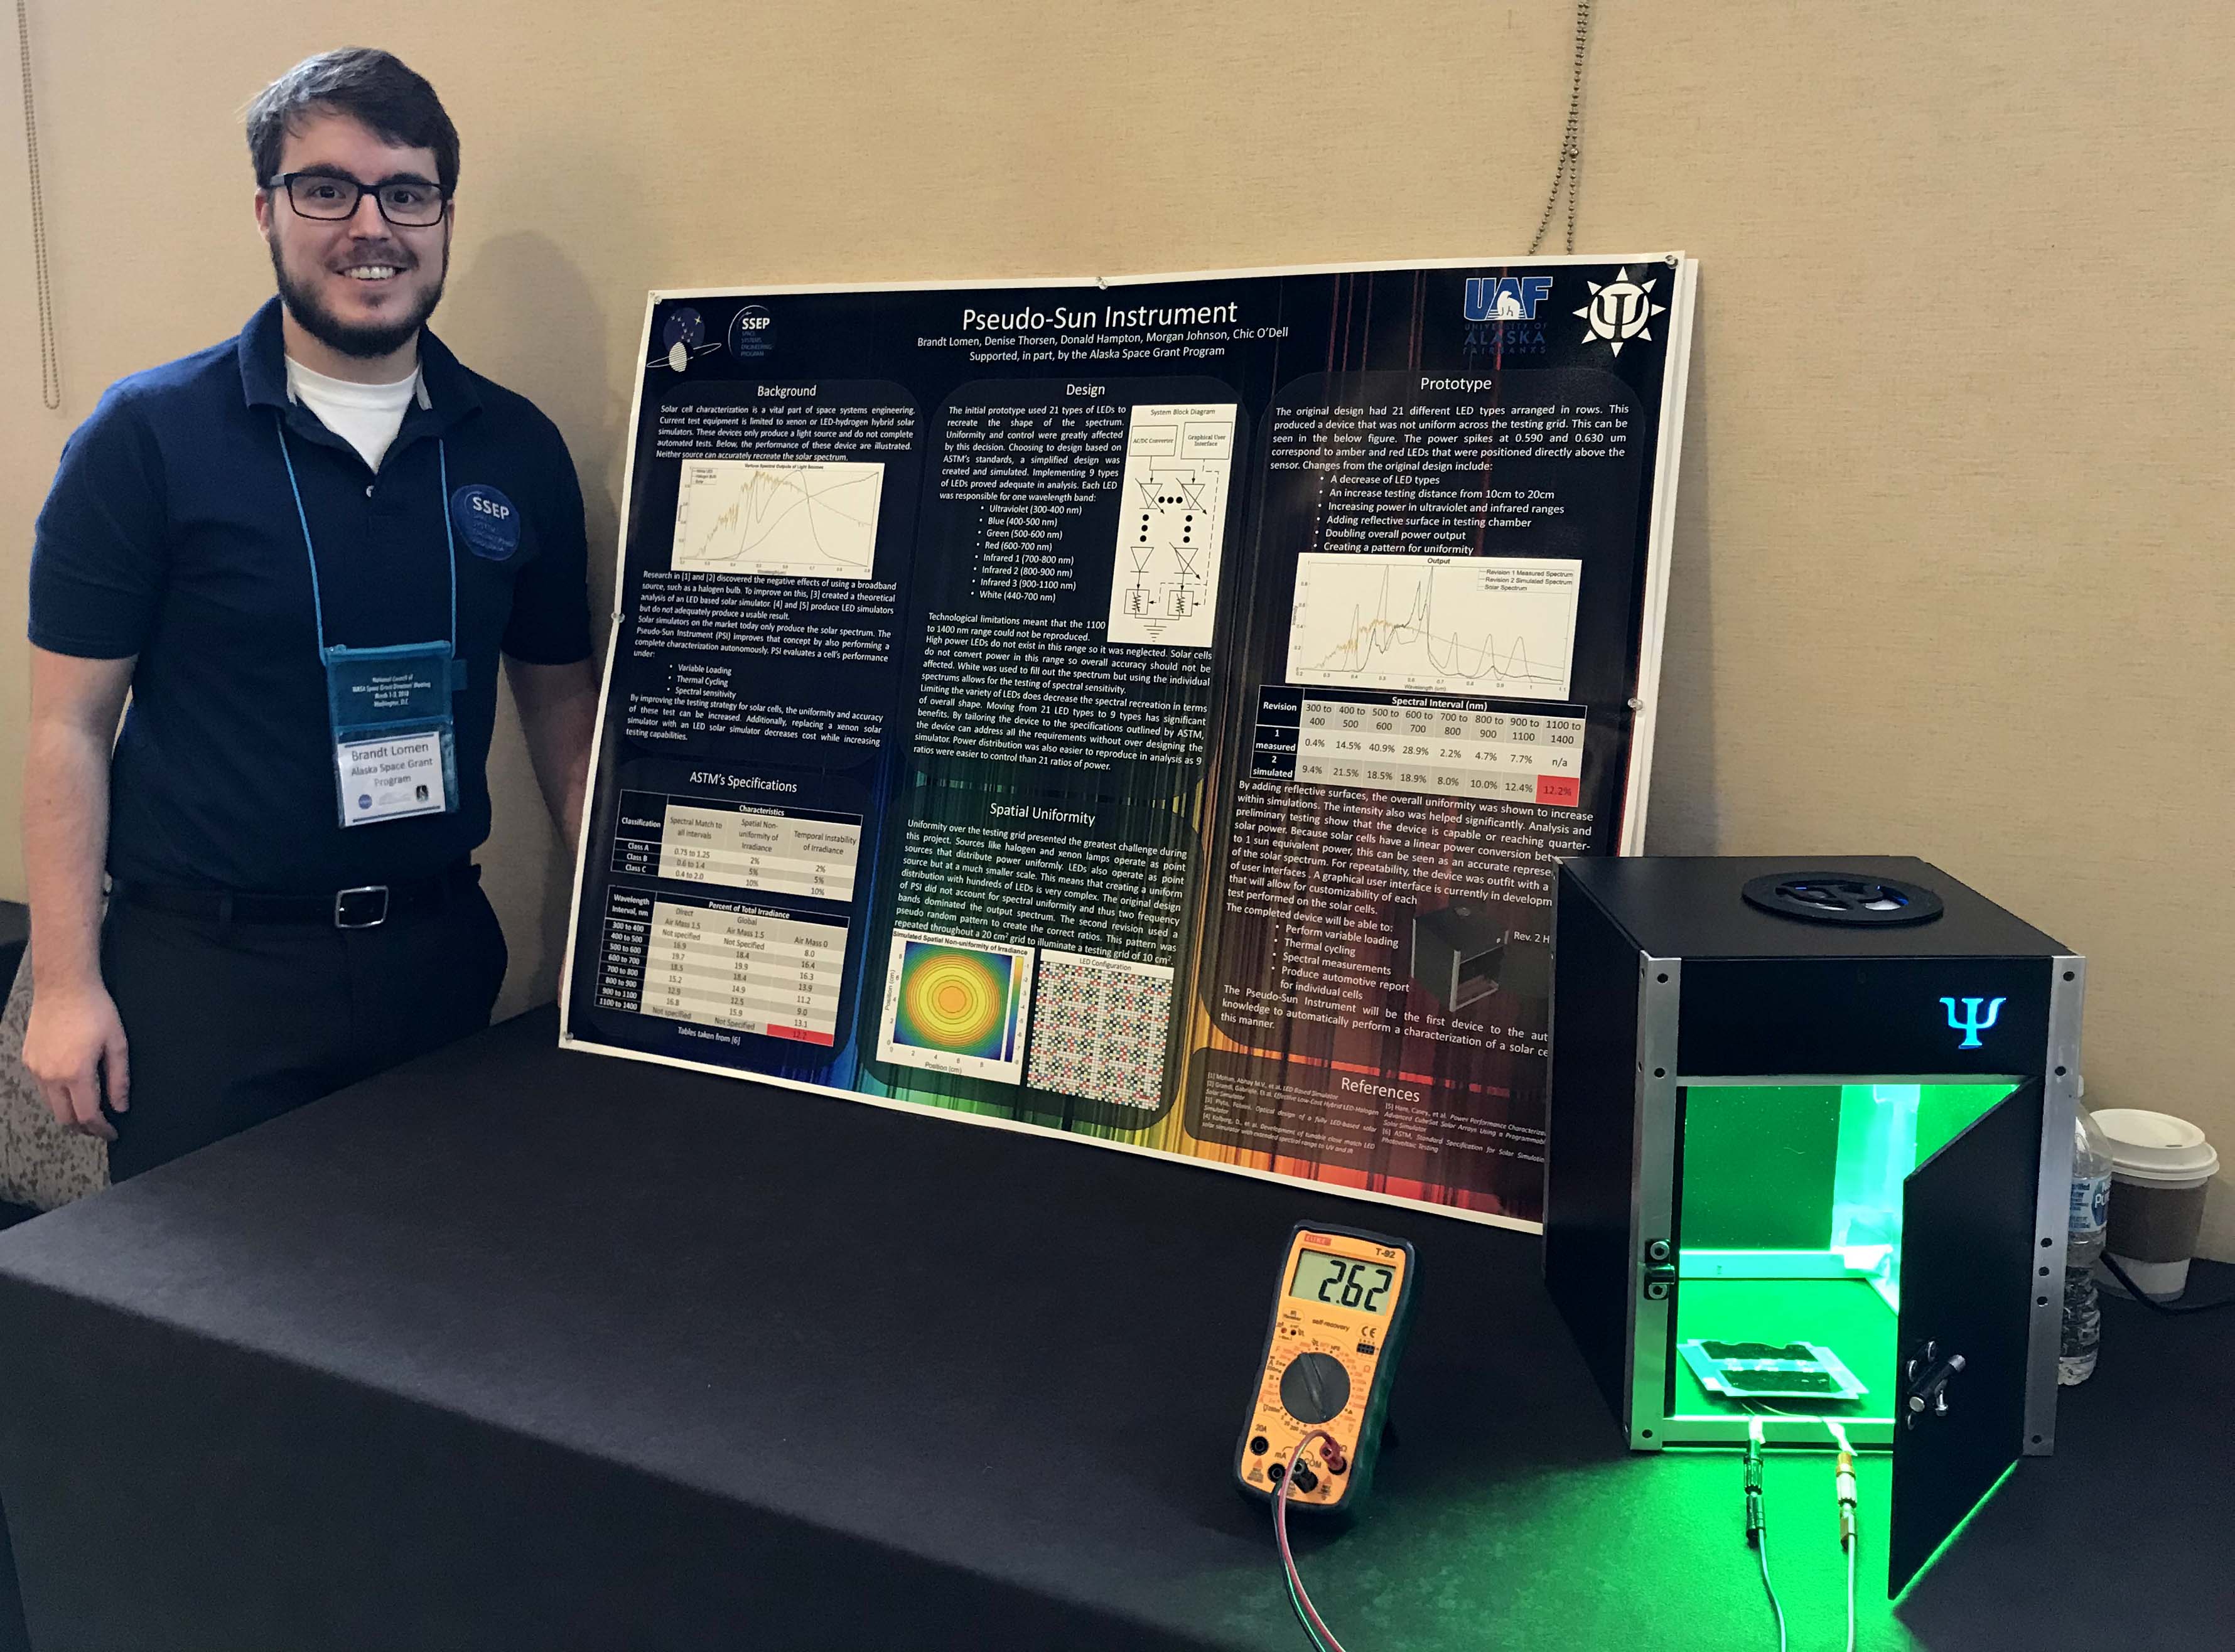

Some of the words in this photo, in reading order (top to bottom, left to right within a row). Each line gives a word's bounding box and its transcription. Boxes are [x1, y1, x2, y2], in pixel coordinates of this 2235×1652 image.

[1464, 276, 1553, 321] UAF
[962, 306, 1096, 331] Pseudo-Sun
[1105, 301, 1238, 328] Instrument
[742, 318, 770, 330] SSEP
[917, 336, 947, 347] Brandt
[949, 336, 982, 347] Lomen,
[984, 335, 1016, 346] Denise
[1018, 335, 1058, 345] Thorsen,
[1060, 333, 1094, 345] Donald
[1096, 333, 1143, 344] Hampton,
[1146, 331, 1184, 343] Morgan
[1185, 330, 1230, 341] Johnson,
[1232, 328, 1254, 339] Chic
[1464, 331, 1546, 345] ALASKA
[969, 350, 1020, 363] Supported,
[1021, 352, 1031, 360] in
[1033, 351, 1055, 362] part,
[1057, 350, 1070, 362] by
[1071, 349, 1087, 360] the
[1089, 348, 1120, 359] Alaska
[1121, 348, 1151, 360] Space
[1152, 347, 1181, 358] Grant
[1182, 346, 1225, 358] Program
[757, 384, 817, 399] Background
[1066, 384, 1106, 398] Design
[1420, 377, 1492, 393] Prototype
[660, 404, 679, 413] Solar
[681, 404, 694, 413] cell
[696, 405, 749, 414] characterization
[751, 405, 758, 414] is
[768, 405, 785, 414] vital
[787, 406, 802, 416] part
[804, 405, 814, 414] of
[816, 407, 836, 416] space
[839, 406, 868, 416] systems
[871, 405, 915, 416] engineering.
[949, 405, 963, 415] The
[964, 405, 986, 414] initial
[988, 406, 1026, 416] prototype
[1028, 405, 1047, 414] used
[1048, 405, 1058, 414] 21
[1062, 406, 1083, 416] types
[1085, 405, 1095, 414] of
[1096, 405, 1115, 414] LEDs
[1118, 405, 1126, 414] to
[1150, 409, 1171, 417] System
[1190, 408, 1215, 416] Diagram
[1276, 407, 1292, 416] The
[1296, 405, 1330, 417] original
[1333, 405, 1364, 417] design
[1369, 405, 1387, 416] had
[1392, 406, 1404, 416] 21
[1409, 405, 1451, 416] different
[1455, 405, 1474, 416] LED
[1479, 406, 1505, 417] types
[1511, 404, 1555, 417] arranged
[1560, 404, 1570, 414] in
[1575, 406, 1603, 414] rows.
[1608, 404, 1629, 414] This
[1330, 474, 1338, 483] A
[1339, 474, 1381, 484] decrease
[1382, 475, 1394, 484] of
[1394, 475, 1413, 485] LED
[1414, 476, 1440, 486] types
[1328, 488, 1342, 497] An
[1344, 488, 1382, 498] increase
[1384, 488, 1416, 500] testing
[1418, 488, 1458, 498] distance
[1460, 488, 1483, 498] from
[1485, 488, 1512, 498] 10cm
[1514, 490, 1525, 499] to
[1527, 490, 1554, 499] 20cm
[473, 496, 510, 520] SSEP
[989, 504, 1029, 513] Ultraviolet
[1030, 504, 1065, 515] (300-400
[1065, 505, 1082, 516] nm)
[1426, 557, 1451, 565] Output
[979, 589, 1003, 599] White
[1003, 591, 1038, 601] (440-700
[1040, 593, 1056, 603] nm)
[677, 663, 705, 673] Variable
[706, 665, 732, 677] Loading
[676, 674, 704, 684] Thermal
[704, 677, 729, 688] Cycling
[675, 686, 702, 695] Spectral
[703, 689, 737, 700] sensitivity
[1263, 702, 1297, 712] Revision
[1389, 696, 1428, 710] Spectral
[1429, 699, 1464, 712] Interval
[1465, 700, 1488, 714] (nm)
[351, 747, 388, 761] Brandt
[390, 743, 429, 756] Lomen
[1253, 741, 1298, 753] measured
[1304, 738, 1325, 748] 0.4%
[1335, 740, 1361, 751] 14.5%
[1368, 743, 1396, 753] 40.9%
[1402, 745, 1429, 756] 28.9%
[1440, 748, 1462, 759] 2.2%
[1474, 751, 1497, 761] 4.7%
[1510, 754, 1532, 764] 7.7%
[1551, 757, 1568, 768] n/a
[351, 766, 378, 776] Alaska
[379, 761, 406, 773] Space
[407, 758, 433, 769] Grant
[1250, 768, 1295, 780] simulated
[727, 775, 797, 793] Specifications
[739, 804, 785, 817] Characteristics
[989, 802, 1029, 818] Spatial
[1032, 807, 1096, 827] Uniformity
[621, 817, 661, 828] Classification
[907, 818, 948, 833] Uniformity
[949, 825, 966, 833] over
[967, 825, 981, 835] the
[982, 827, 1008, 840] testing
[1009, 830, 1026, 840] grid
[1026, 834, 1067, 844] presented
[1068, 836, 1082, 846] the
[1083, 840, 1117, 850] greatest
[1118, 842, 1158, 856] challenge
[1159, 846, 1187, 860] during
[627, 842, 644, 850] Class
[644, 844, 649, 852] A
[1285, 924, 1323, 937] Perform
[1324, 931, 1362, 943] variable
[1364, 934, 1399, 950] loading
[1079, 957, 1091, 965] LED
[1091, 958, 1132, 971] Configuration
[677, 1026, 697, 1037] Tables
[697, 1030, 714, 1040] taken
[714, 1032, 731, 1043] from
[1341, 1076, 1420, 1102] References
[1376, 1248, 1396, 1258] T-92
[1318, 1260, 1392, 1312] 2.62
